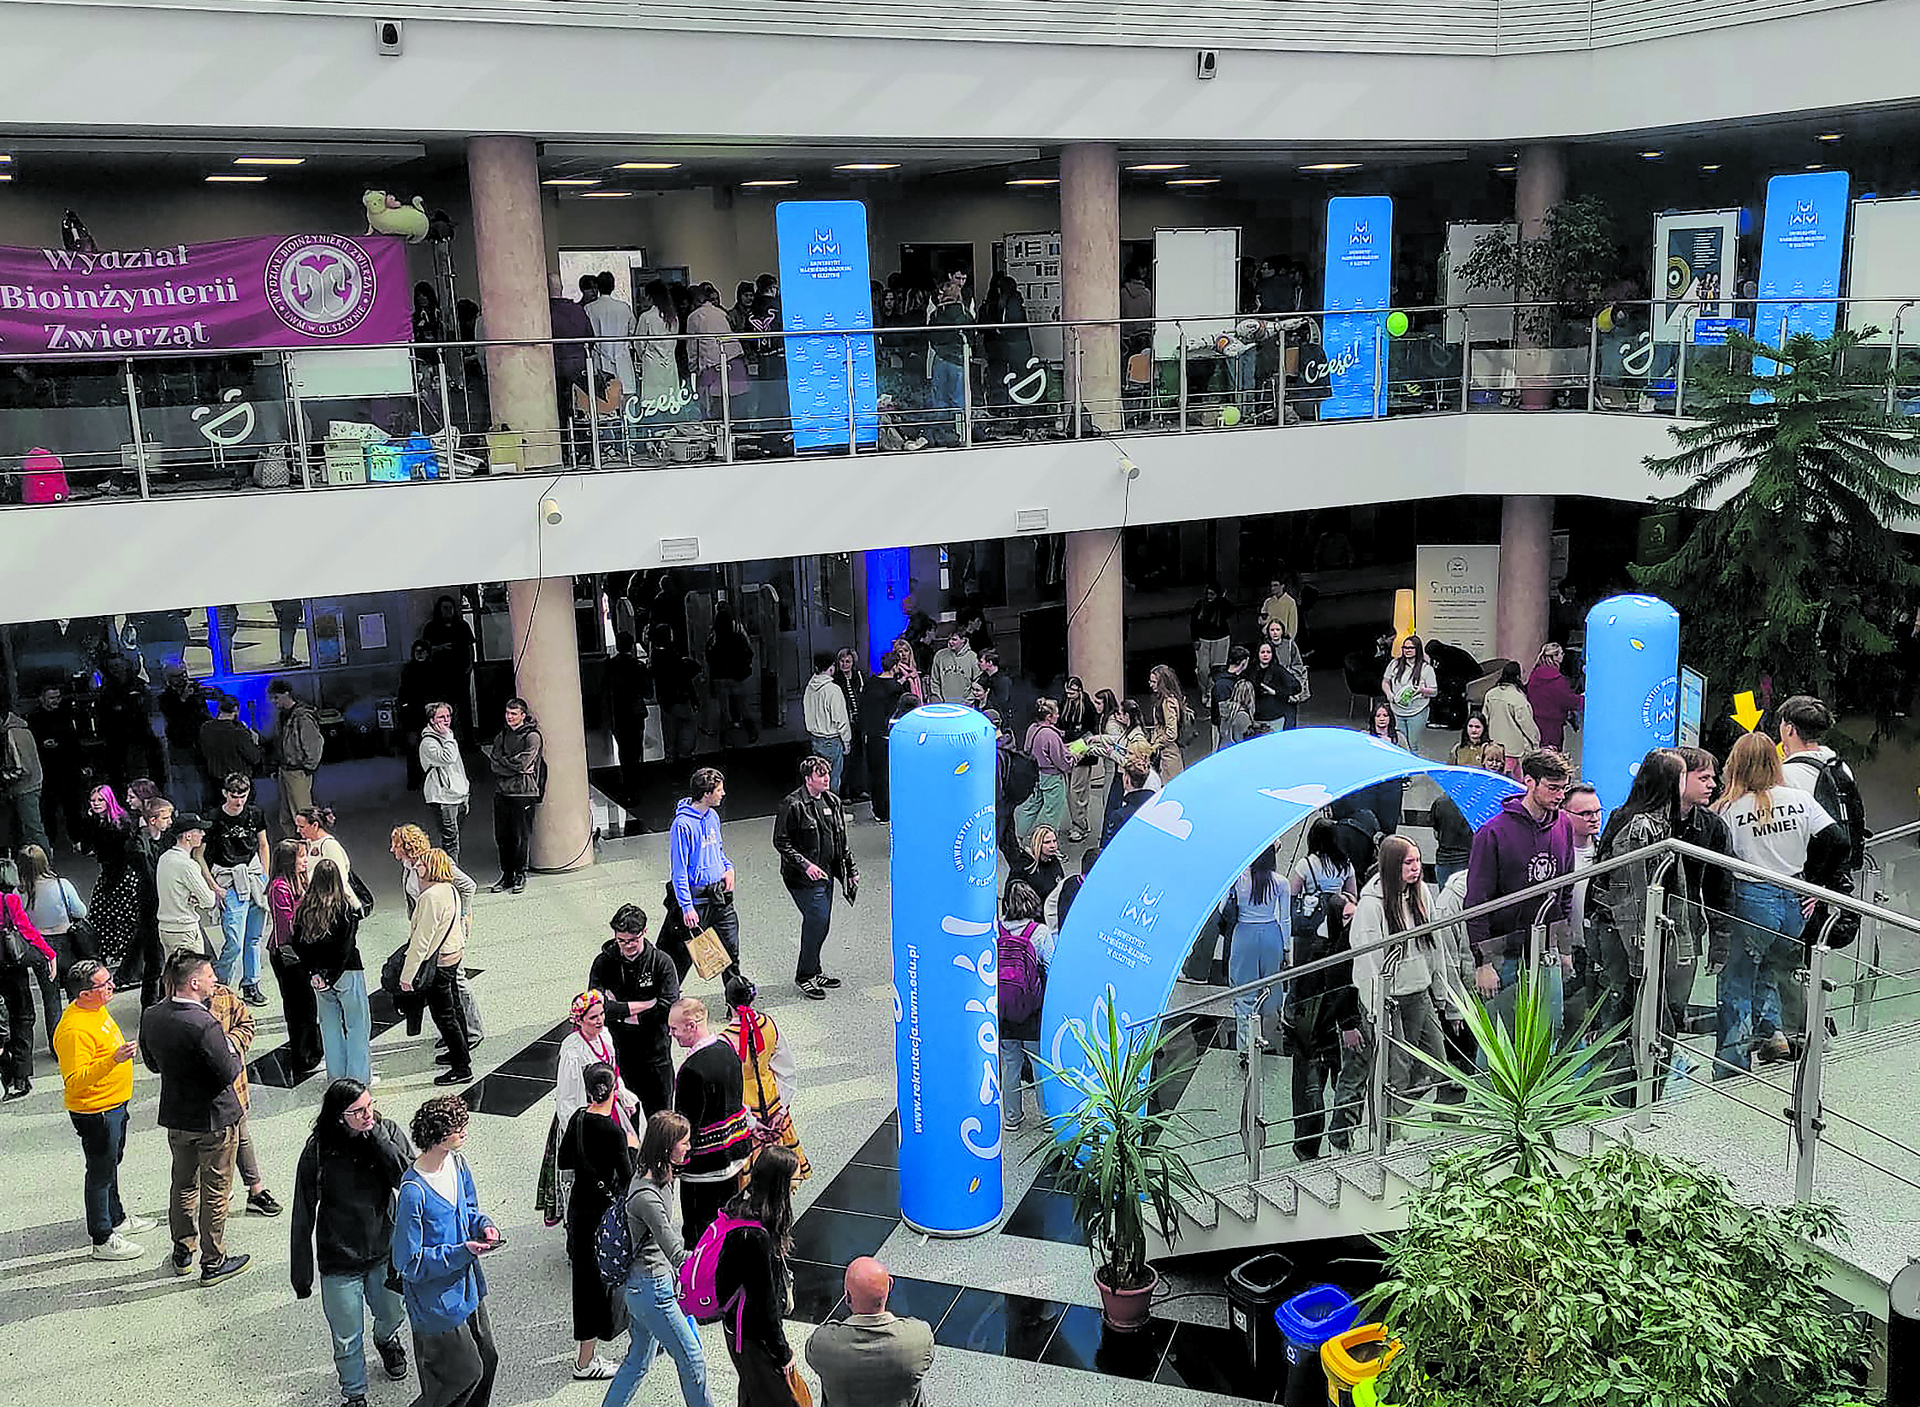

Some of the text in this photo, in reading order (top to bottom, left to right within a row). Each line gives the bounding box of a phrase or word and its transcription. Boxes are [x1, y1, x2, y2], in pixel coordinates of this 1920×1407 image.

[42, 245, 190, 275] Wydział
[0, 277, 240, 313] Bioinżynierii
[284, 311, 306, 330] UWM
[319, 304, 366, 333] OLSZTYNIE
[44, 322, 211, 349] Zwierząt
[1305, 340, 1360, 384] Cześć!
[625, 372, 699, 423] Cześć!
[1752, 819, 1797, 837] MNIE!
